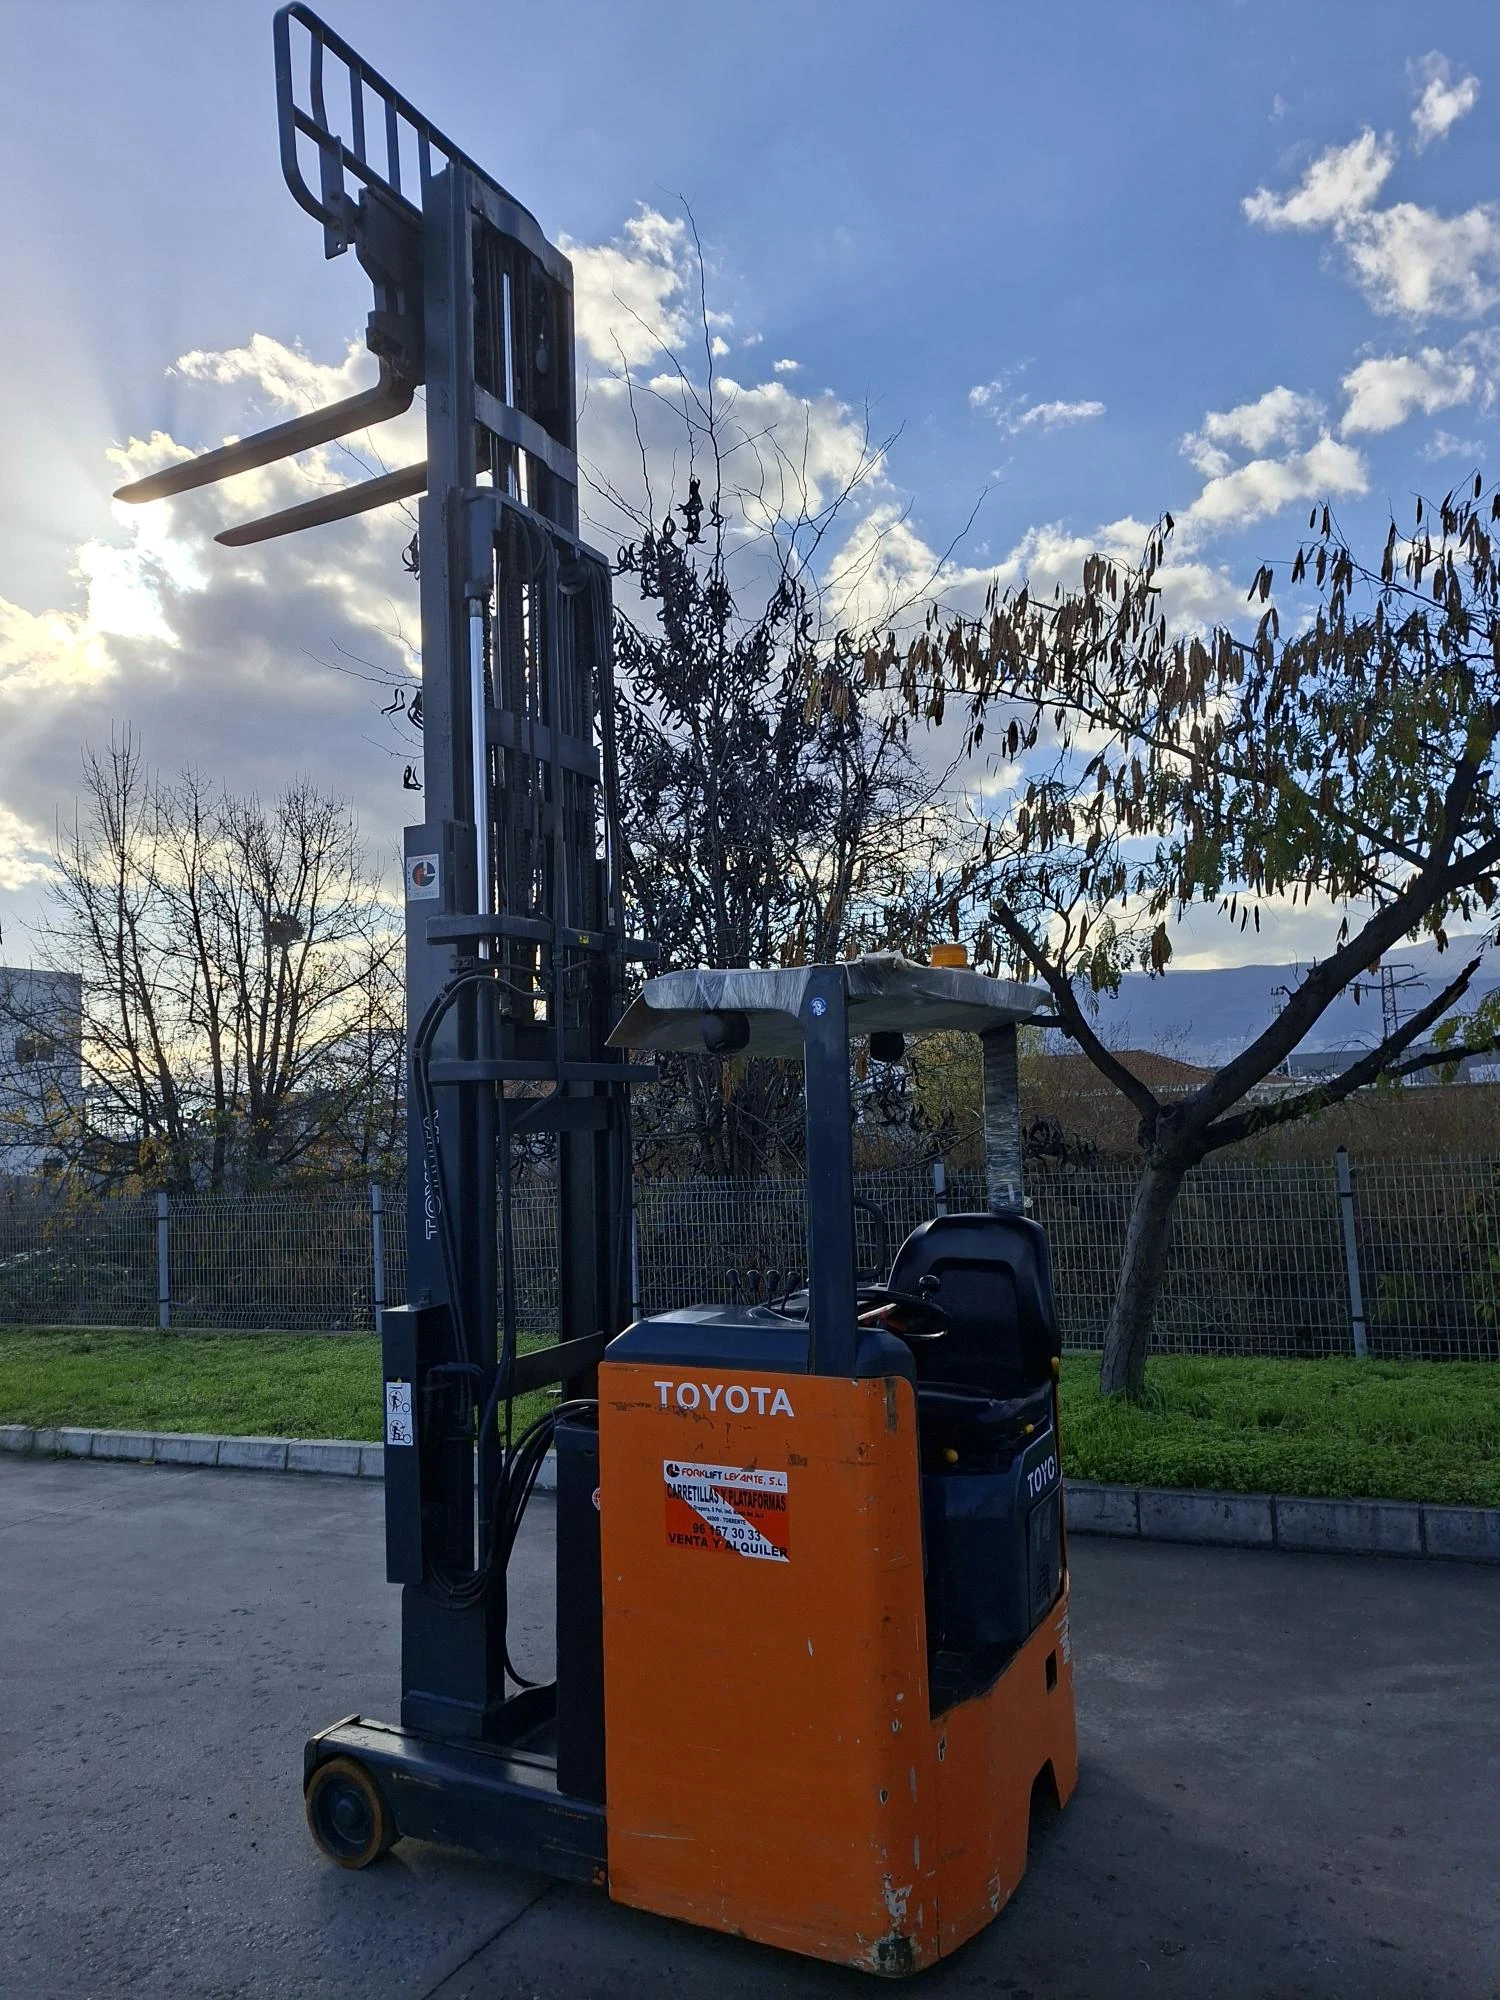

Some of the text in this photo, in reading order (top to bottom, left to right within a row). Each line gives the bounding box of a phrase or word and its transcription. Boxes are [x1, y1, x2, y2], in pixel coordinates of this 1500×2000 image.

[654, 1381, 795, 1418] TOYOTA
[681, 1467, 723, 1481] FORKLIFT
[666, 1483, 786, 1512] CARRETILLAS Y PLATAFORMAS
[668, 1532, 788, 1558] VENTA Y ALQUILER
[692, 1522, 761, 1542] 96 157 30 33
